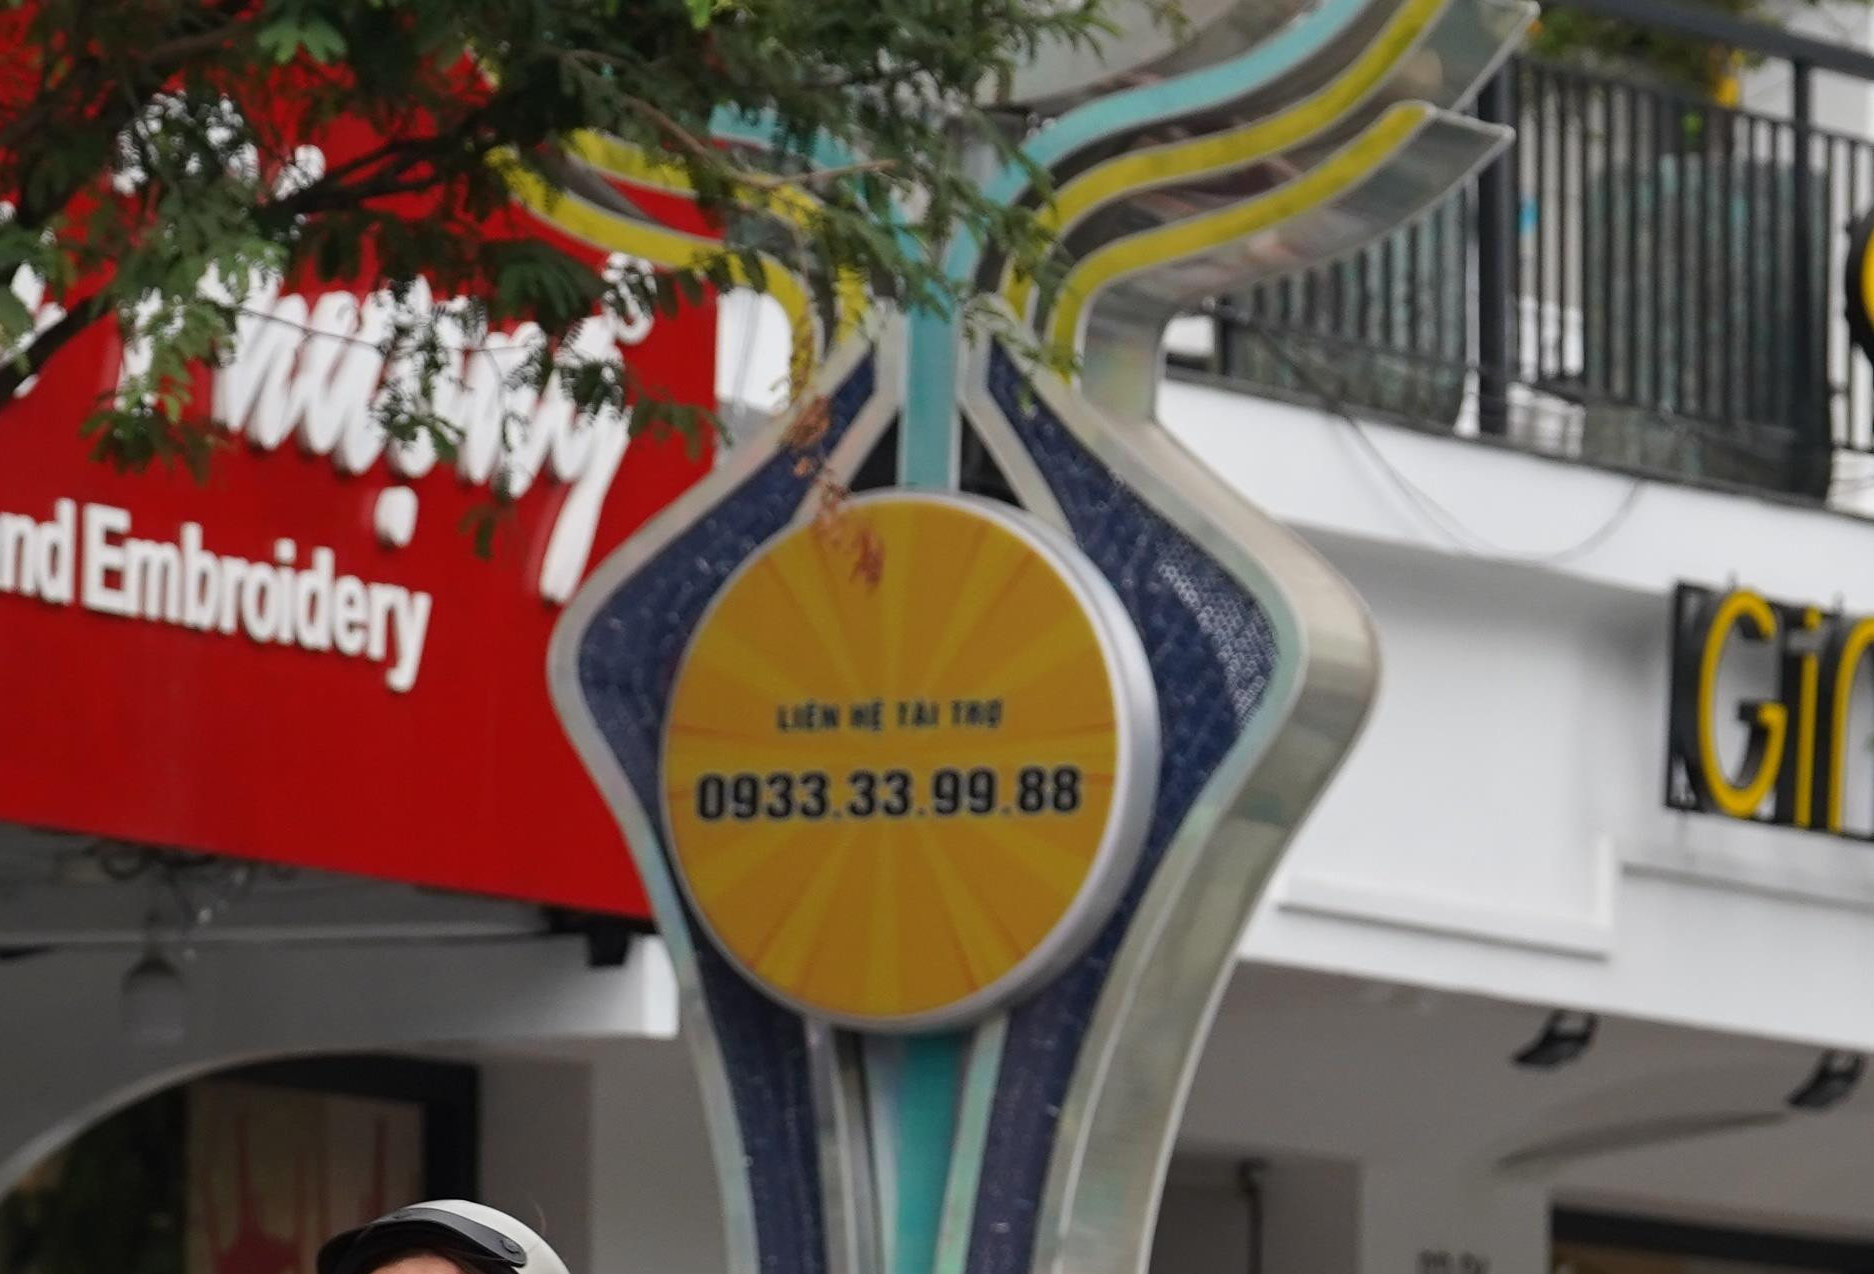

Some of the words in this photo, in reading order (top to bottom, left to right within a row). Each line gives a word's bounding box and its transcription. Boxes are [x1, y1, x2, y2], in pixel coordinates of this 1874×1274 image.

[81, 502, 433, 694] Embroidery
[777, 698, 839, 732] LIÊN
[849, 696, 885, 734] HỆ
[696, 765, 1082, 822] 0933.33.99.88
